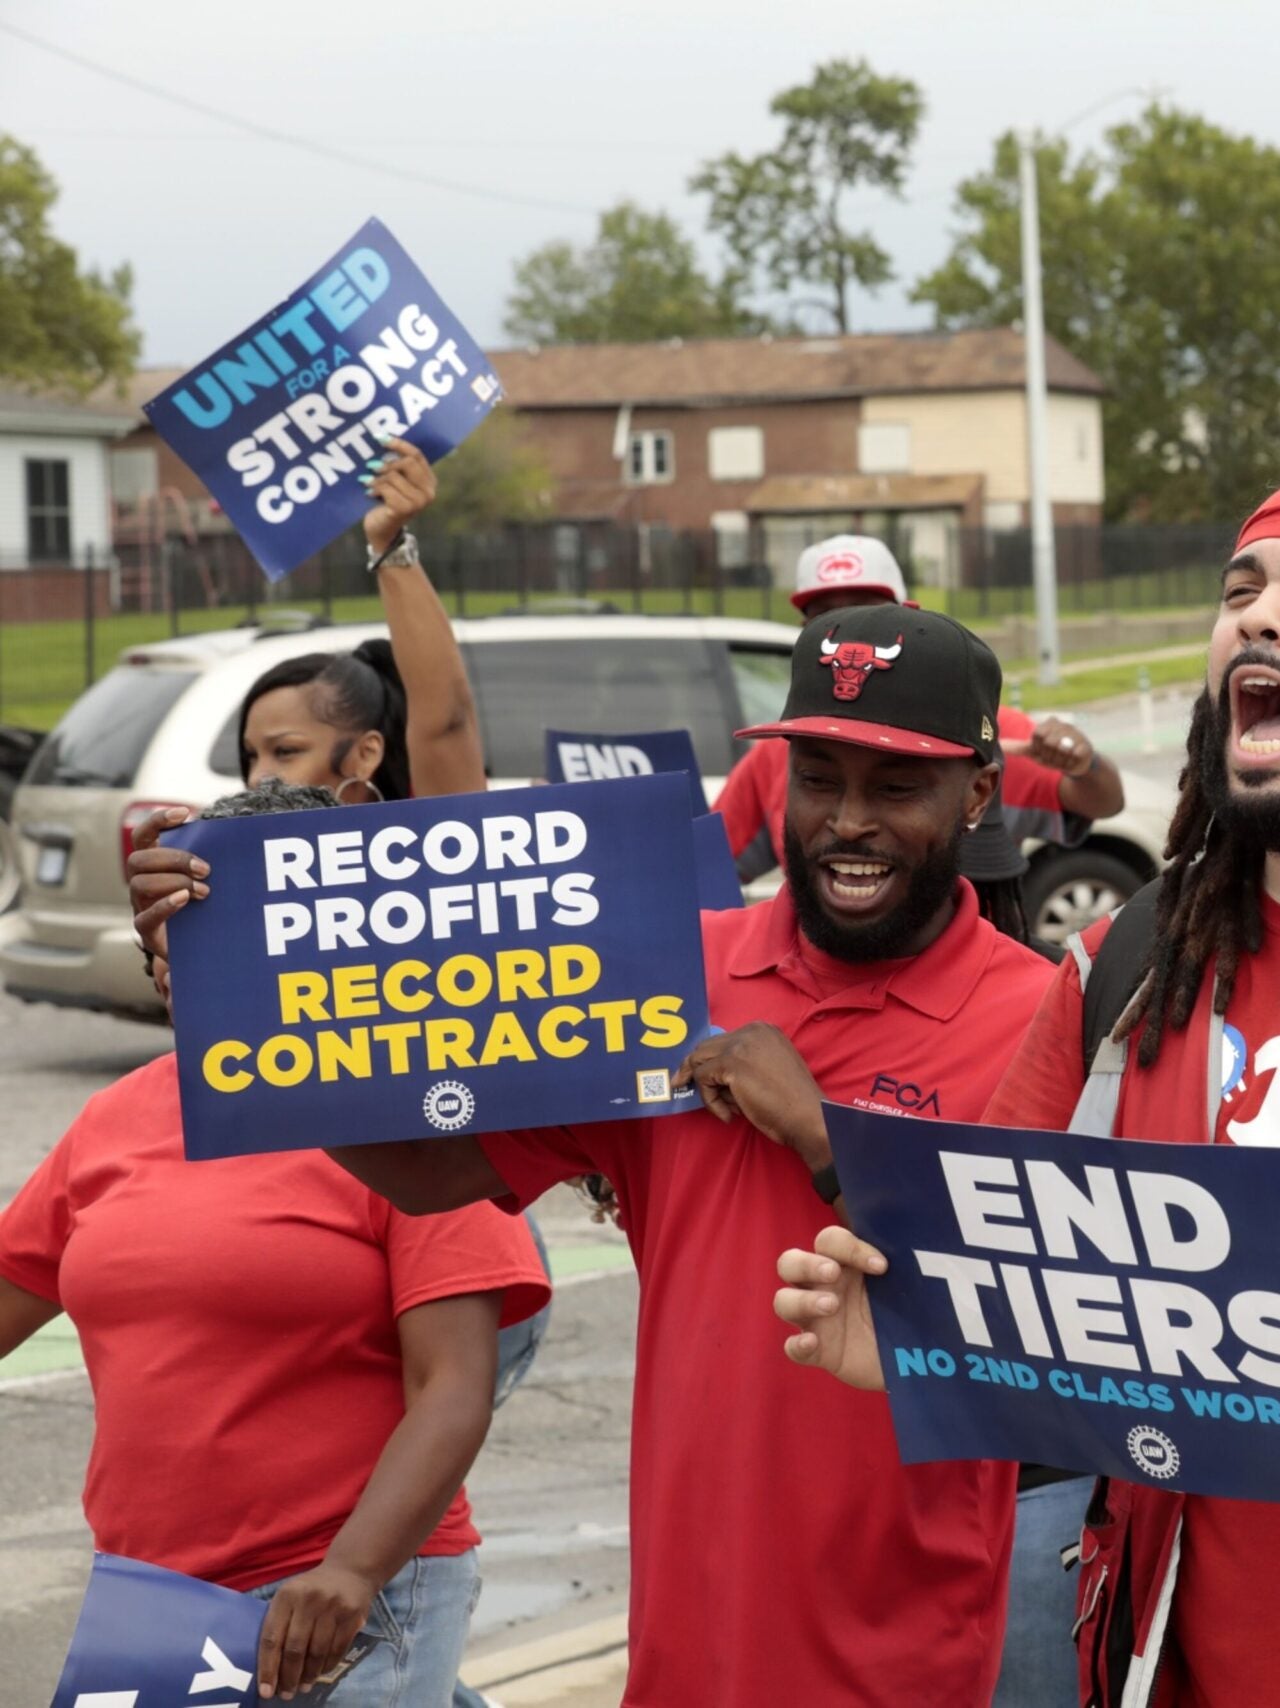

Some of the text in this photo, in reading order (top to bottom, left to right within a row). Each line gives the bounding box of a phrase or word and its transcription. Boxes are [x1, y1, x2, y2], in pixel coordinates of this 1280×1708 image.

[171, 247, 391, 429] UNITED
[284, 344, 350, 399] FOR A
[227, 303, 439, 487] STRONG
[256, 339, 468, 524] CONTRACT
[557, 742, 654, 783] END
[263, 810, 588, 892] RECORD
[264, 873, 599, 956] PROFITS
[278, 944, 601, 1024] RECORD
[202, 995, 688, 1093] CONTRACTS
[853, 1097, 869, 1108] FIAT
[870, 1073, 941, 1117] FCA
[938, 1150, 1231, 1272] END
[894, 1348, 956, 1379] NO
[967, 1355, 1040, 1390] 2ND
[1048, 1368, 1174, 1412] CLASS
